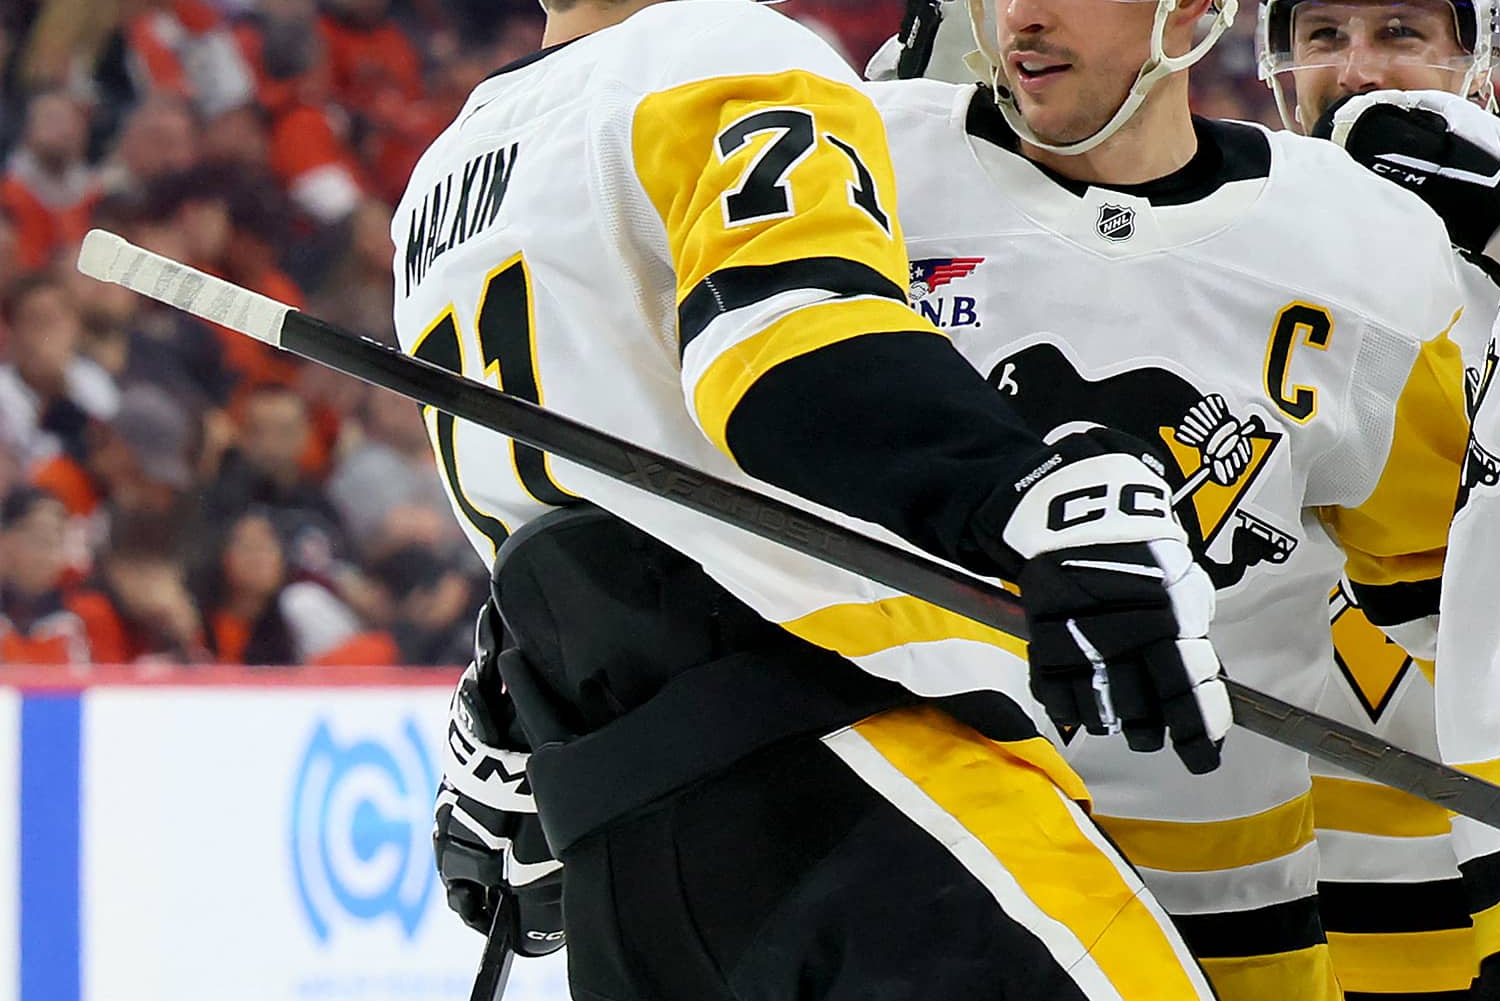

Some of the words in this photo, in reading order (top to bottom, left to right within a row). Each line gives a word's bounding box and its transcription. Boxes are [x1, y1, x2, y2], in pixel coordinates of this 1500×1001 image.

[406, 142, 519, 298] MALKIN
[1103, 214, 1129, 233] NHL
[1263, 300, 1334, 424] C
[1014, 453, 1063, 492] PENGUINS
[527, 930, 566, 942] CC
